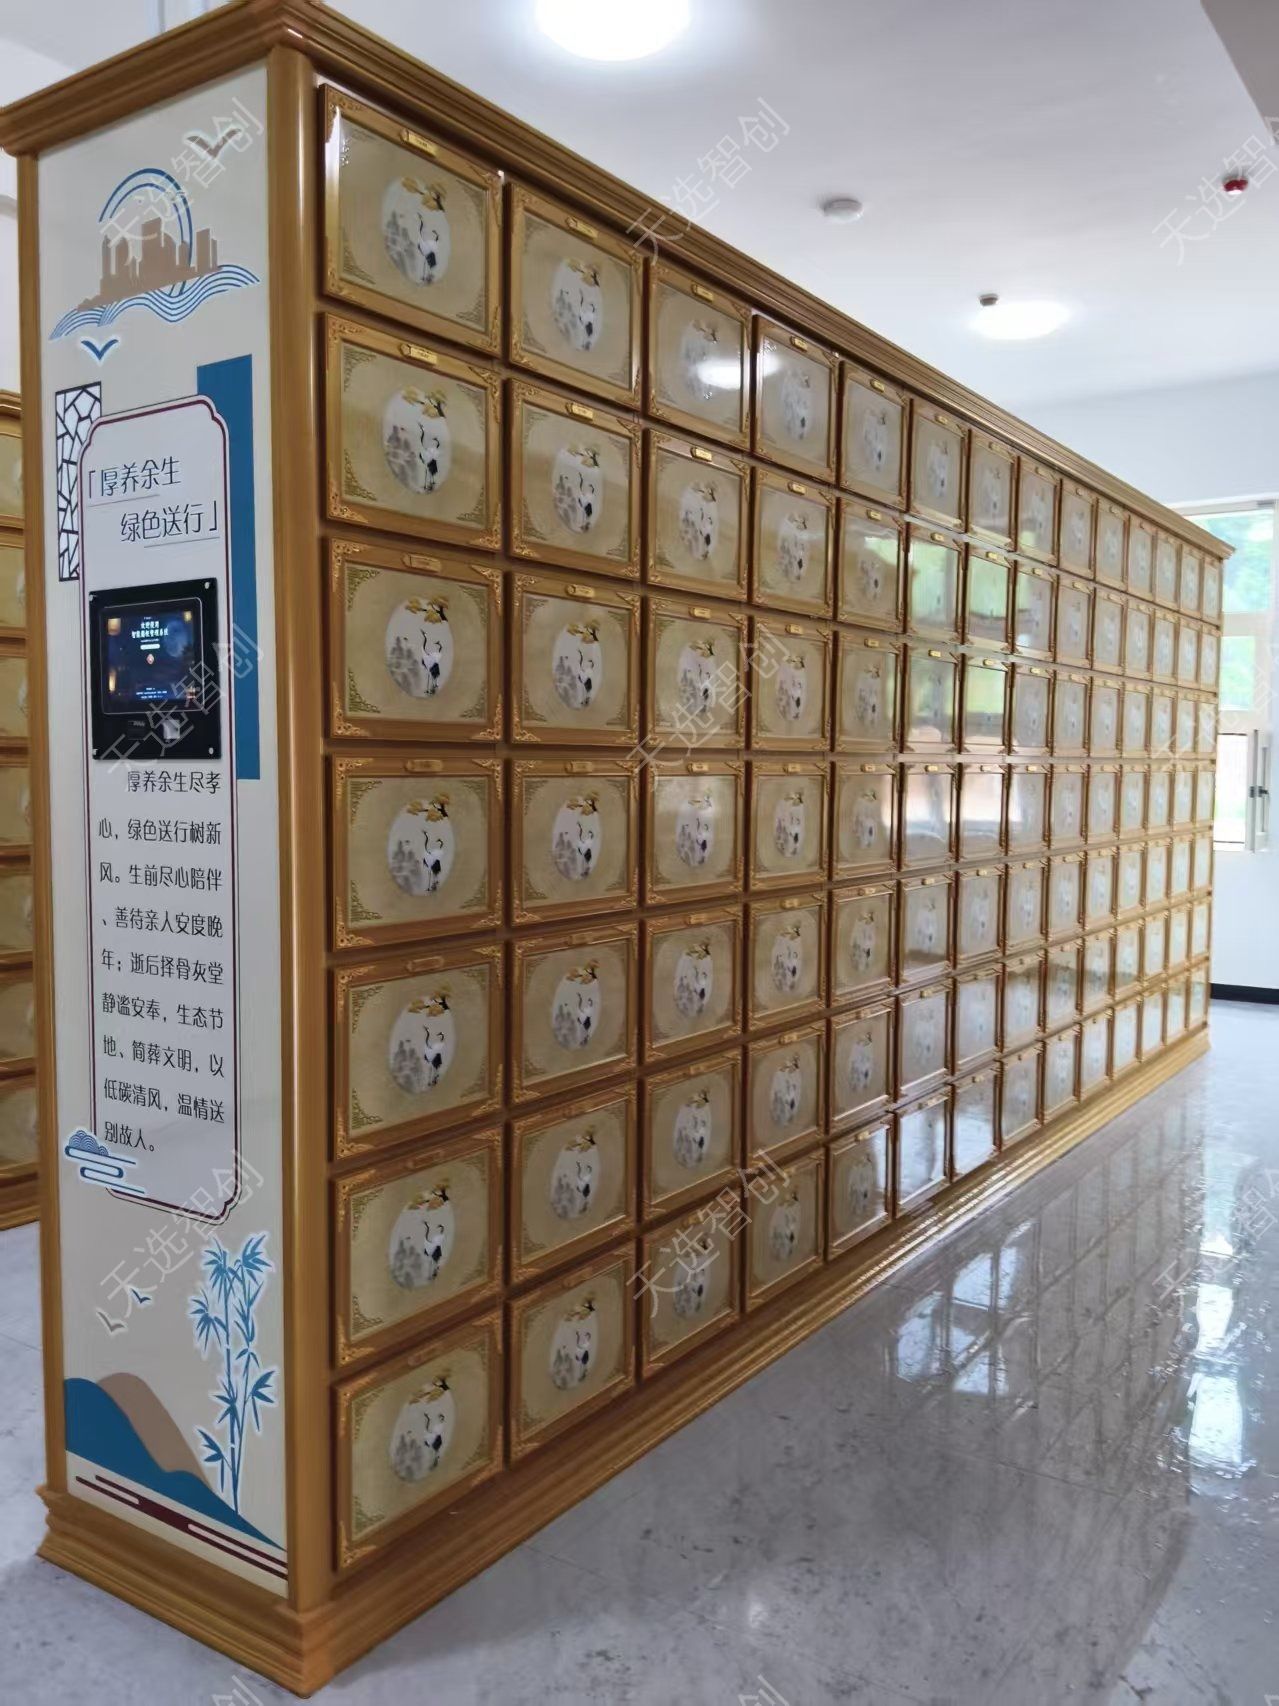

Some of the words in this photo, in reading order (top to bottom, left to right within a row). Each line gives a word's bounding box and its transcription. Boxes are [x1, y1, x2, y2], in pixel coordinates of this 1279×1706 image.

[127, 770, 221, 794] 厚养余生尽孝
